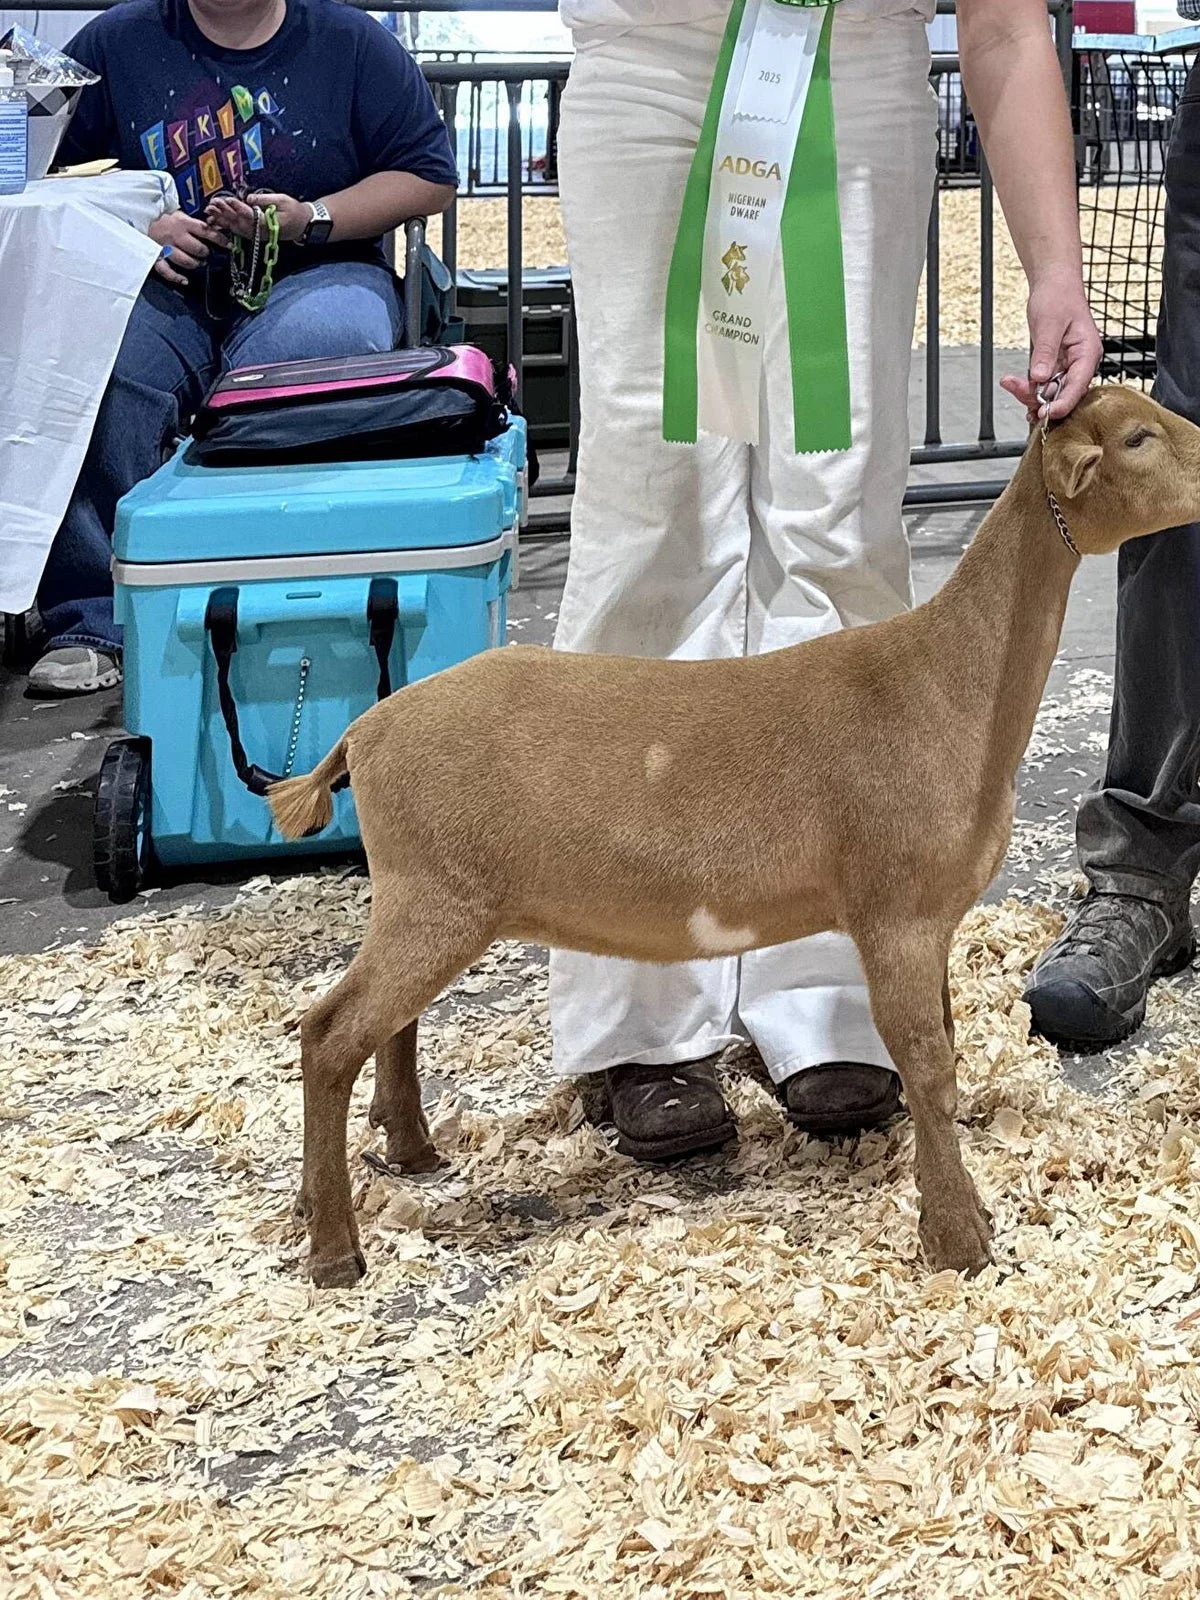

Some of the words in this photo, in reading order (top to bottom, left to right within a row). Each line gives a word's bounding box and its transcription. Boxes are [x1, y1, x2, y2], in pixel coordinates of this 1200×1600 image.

[758, 70, 781, 84] 2025
[143, 87, 273, 168] ESKIMO
[718, 155, 782, 181] ADGA
[728, 192, 767, 208] NIGERIAN
[730, 206, 760, 221] DWARF
[712, 310, 752, 328] GRAND
[704, 323, 760, 345] CHAMPION
